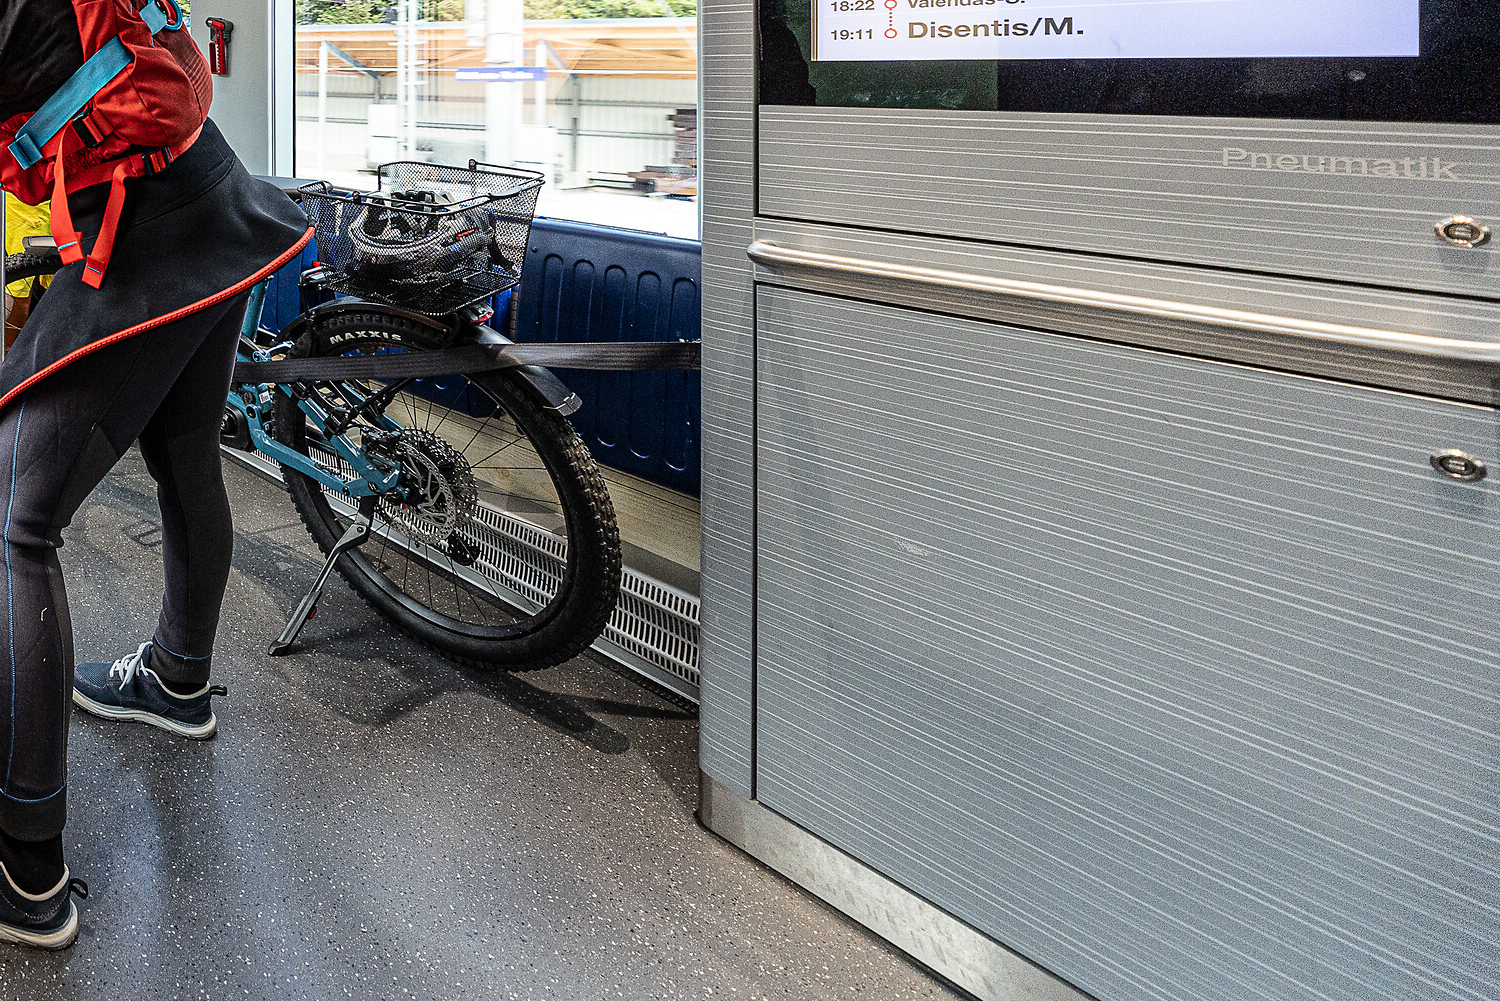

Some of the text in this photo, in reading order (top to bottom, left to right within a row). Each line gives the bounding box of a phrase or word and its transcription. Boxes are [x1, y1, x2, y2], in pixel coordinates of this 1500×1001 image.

[830, 0, 875, 12] 18:22
[830, 16, 1084, 41] 19:11 Disentis/M.
[1222, 147, 1461, 181] Pneumatik
[329, 330, 402, 345] MAXXIS
